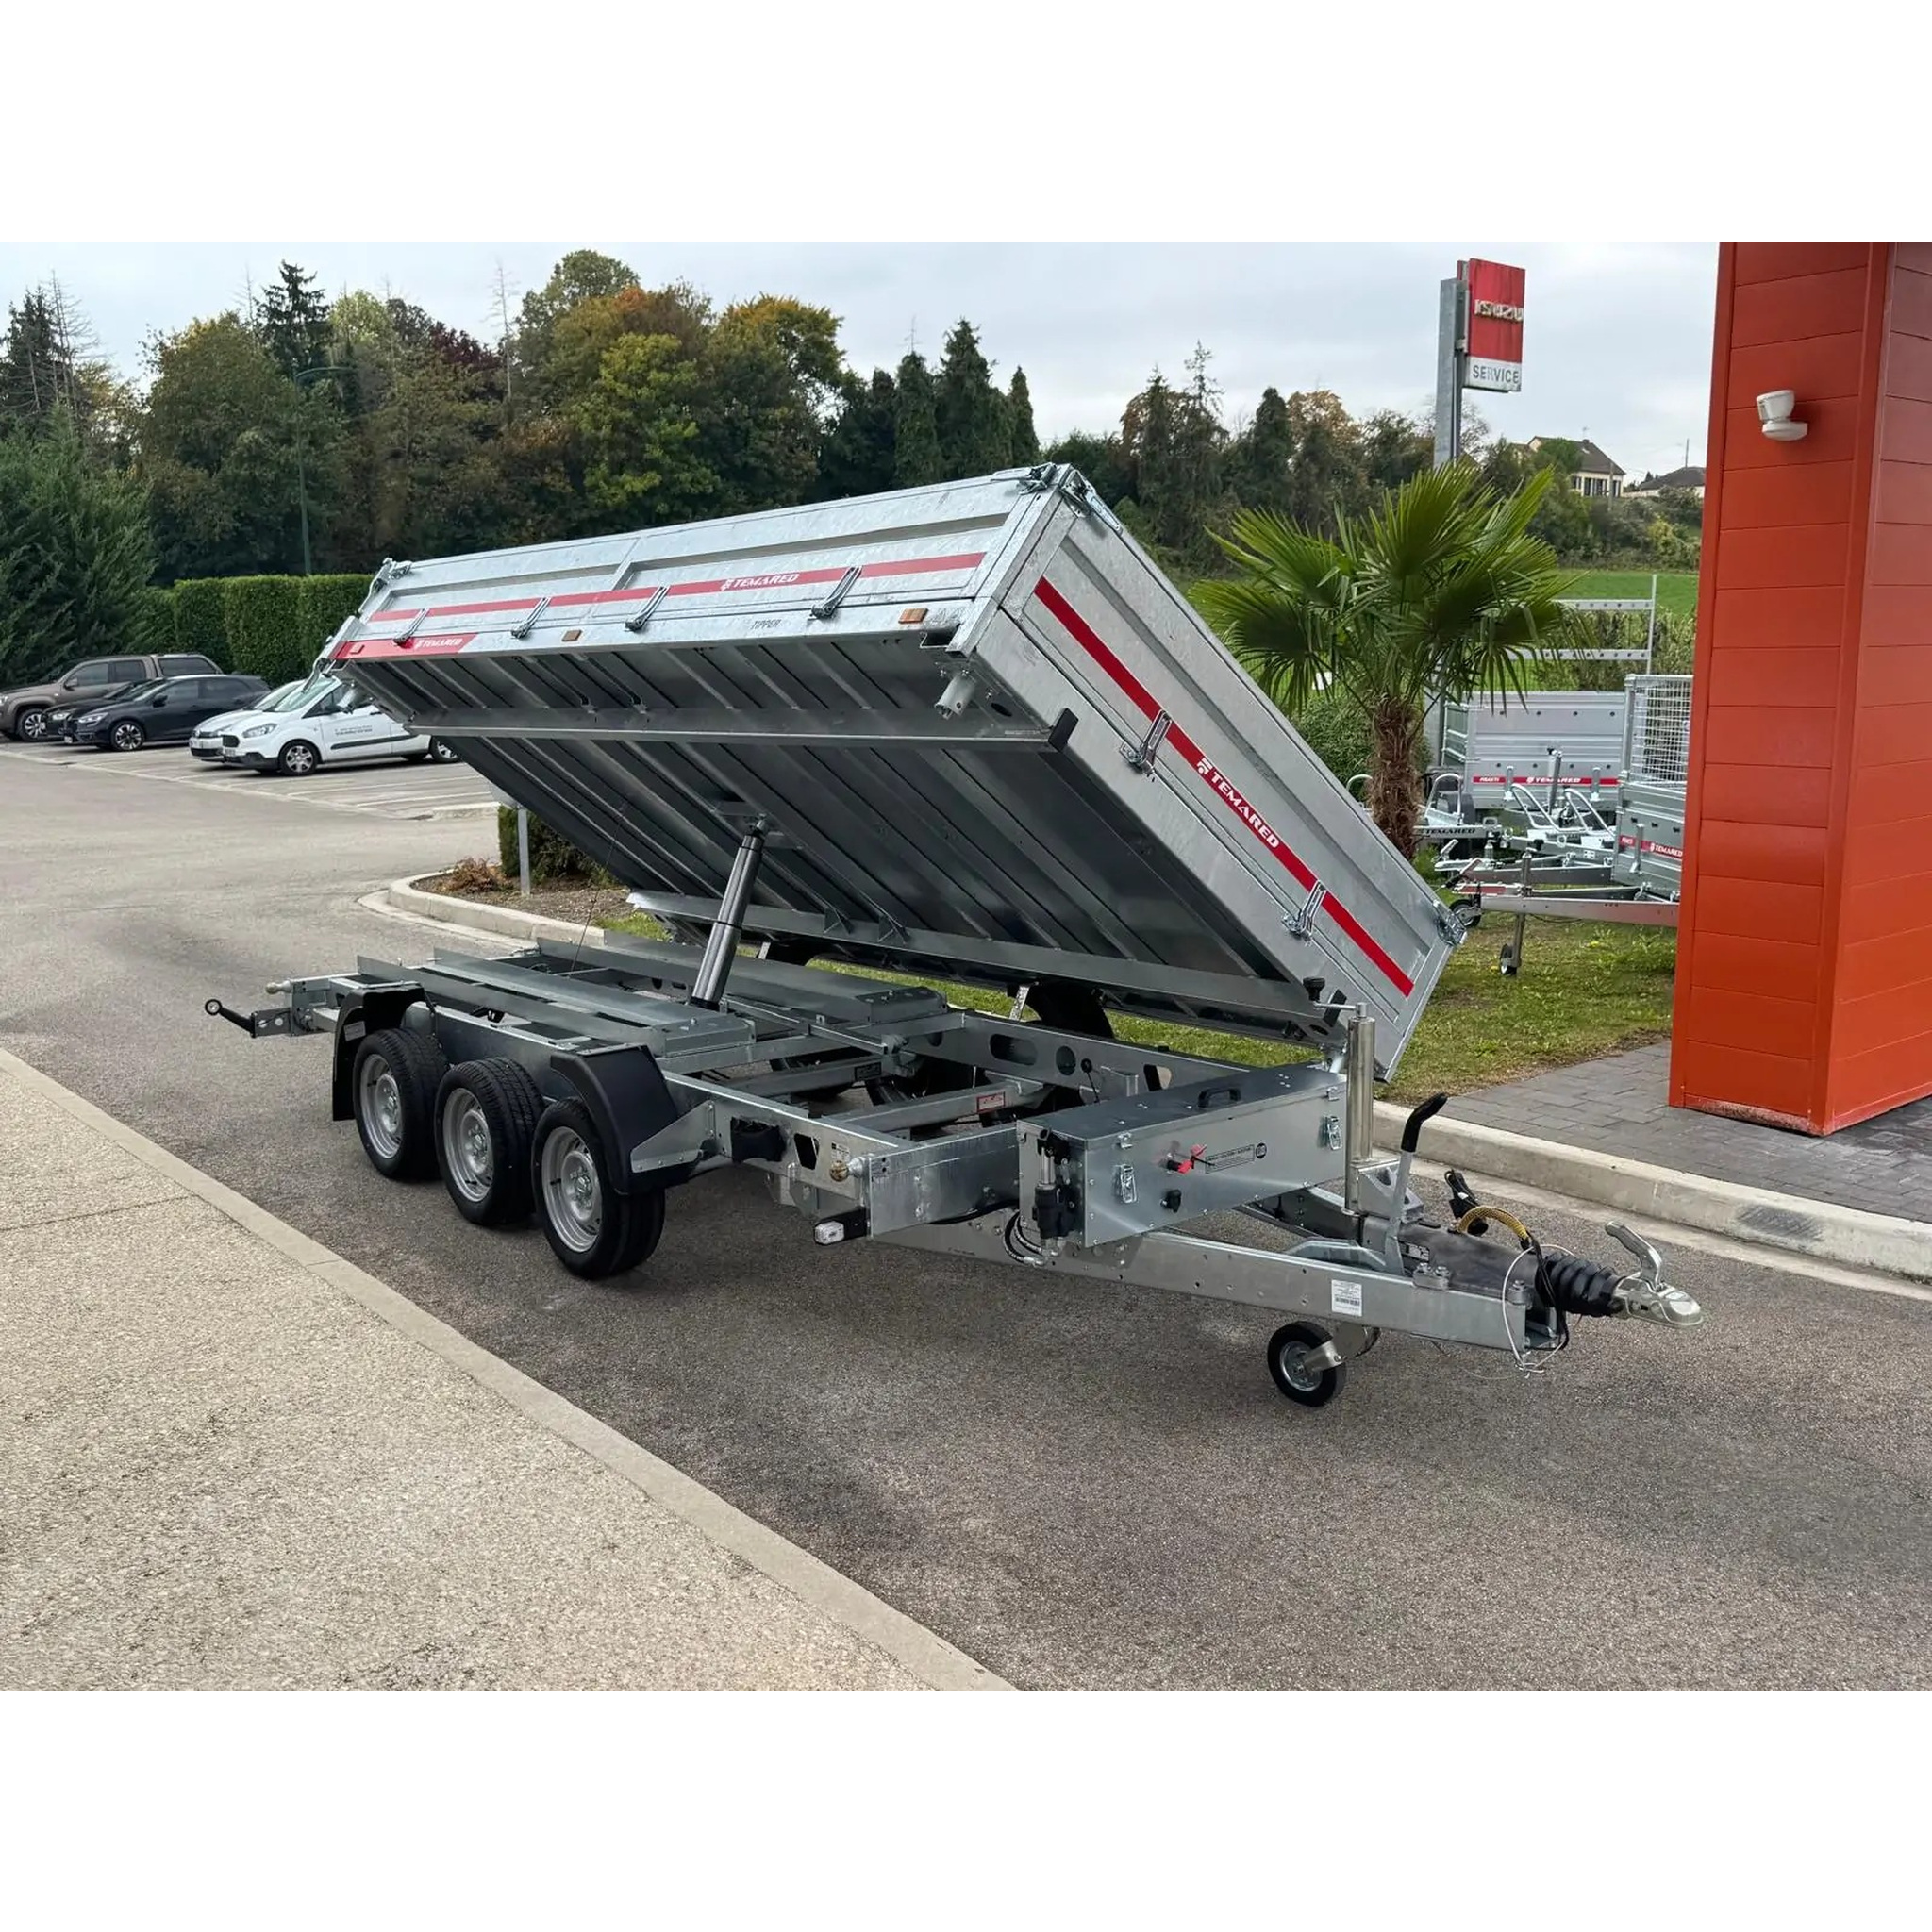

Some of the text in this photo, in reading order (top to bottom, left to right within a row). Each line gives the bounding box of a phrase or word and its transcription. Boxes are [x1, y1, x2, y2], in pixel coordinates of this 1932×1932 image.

[1473, 364, 1520, 384] SERVICE
[733, 574, 800, 588] TEMARED
[1211, 771, 1280, 848] TEMARED
